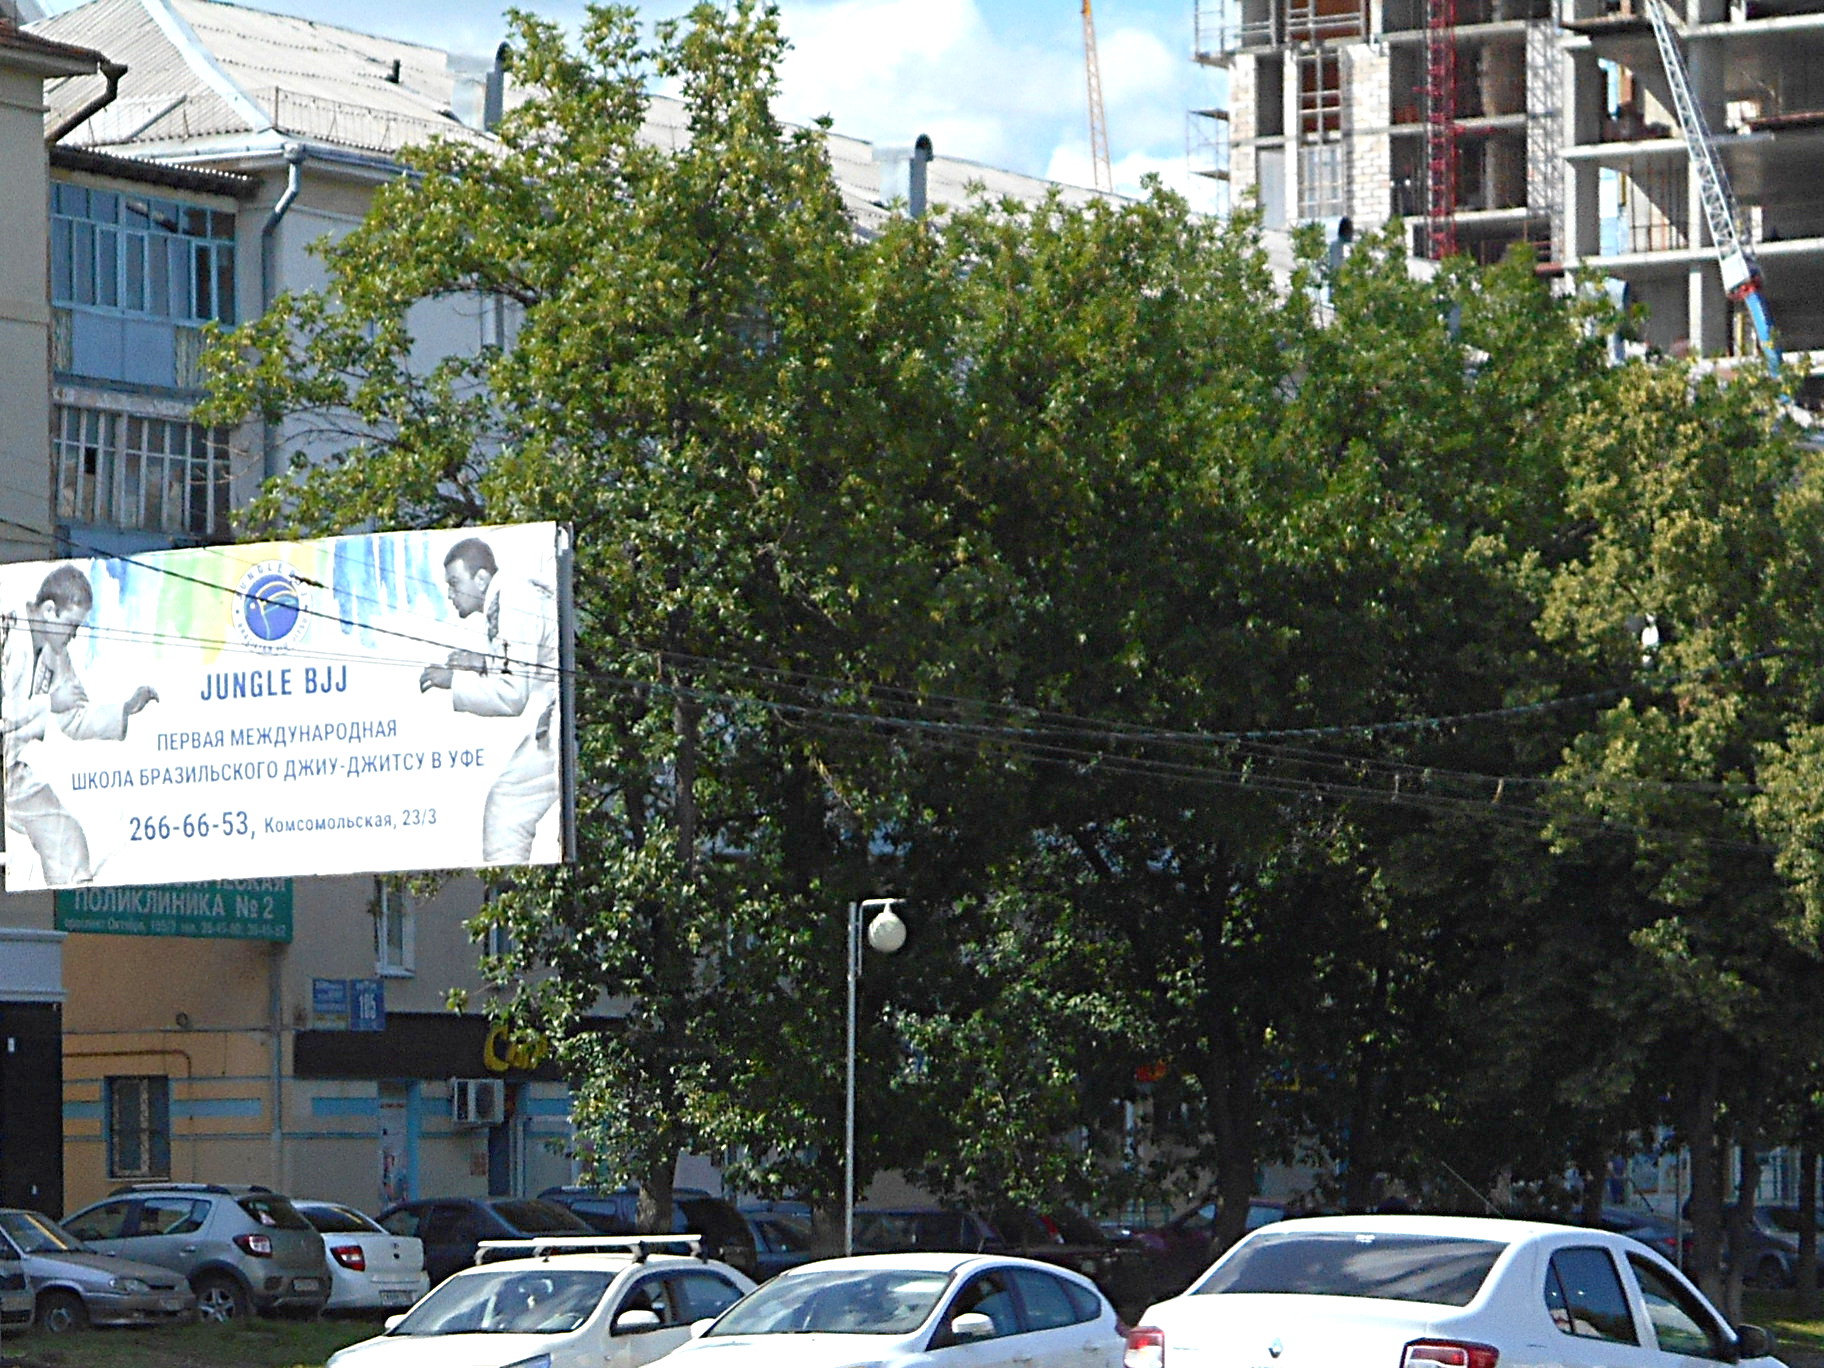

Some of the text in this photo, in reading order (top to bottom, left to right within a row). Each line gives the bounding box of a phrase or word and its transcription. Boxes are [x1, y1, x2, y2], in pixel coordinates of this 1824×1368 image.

[200, 664, 348, 701] JUNGLE BJJ
[157, 719, 398, 752] ПЕРВАЯ МЕЖДУНАРОДНАЯ
[71, 747, 485, 791] ШКОЛА БРАЗИЛЬСКОГО ДЖИУ-ДЖИТСУ В УФЕ
[129, 808, 438, 842] 266-66-53, Комсомольская, 23/3
[75, 886, 274, 919] ПОЛИКЛИНИКА № 2
